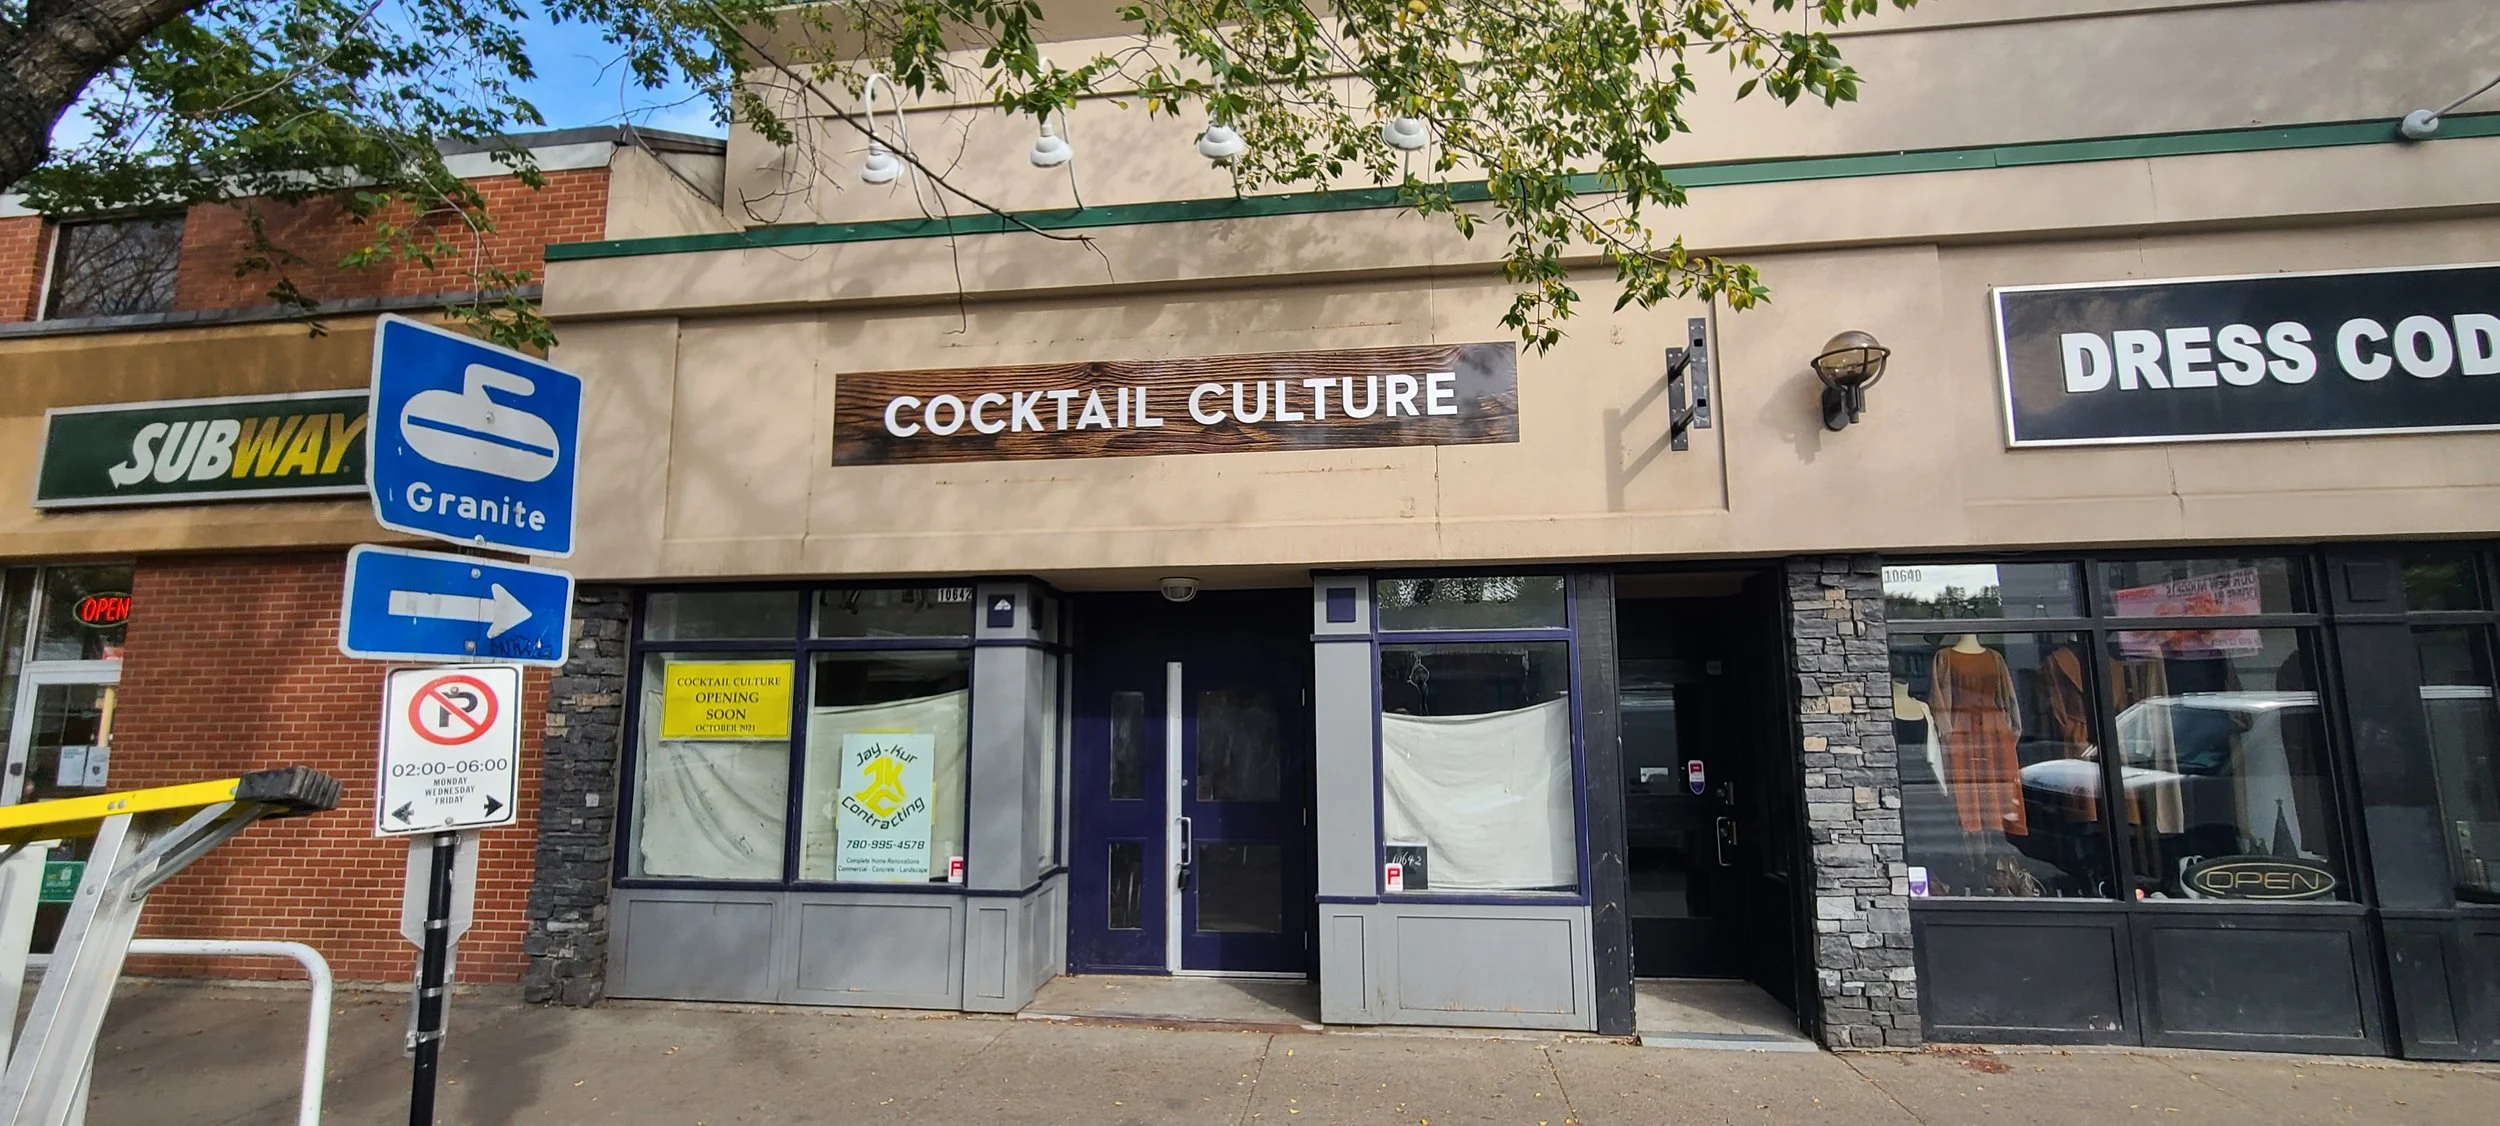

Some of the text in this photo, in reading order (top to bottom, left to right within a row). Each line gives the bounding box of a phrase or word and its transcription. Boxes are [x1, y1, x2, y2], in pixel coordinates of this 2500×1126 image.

[2060, 313, 2500, 393] DRESS COD
[884, 371, 1458, 438] COCKTAIL CULTURE
[109, 413, 367, 489] SUBWAY
[406, 481, 546, 531] Granite
[1884, 569, 1922, 583] 10640
[940, 588, 972, 601] 10642
[83, 596, 132, 622] OPEN
[677, 676, 781, 687] COCKTAIL CULTURE
[695, 691, 760, 704] OPENING
[705, 708, 747, 720] SOON
[695, 723, 756, 733] OCTOBER 2021
[856, 742, 882, 767] Jay
[890, 744, 918, 763] Kur
[392, 758, 508, 777] 02:00-06:00
[433, 776, 468, 786] MONDAY
[424, 785, 476, 797] WEDNESDAY
[434, 795, 464, 805] FRIDAY
[841, 796, 926, 830] Contracting
[845, 839, 925, 850] 780-995-4578
[2206, 872, 2319, 890] OPEN
